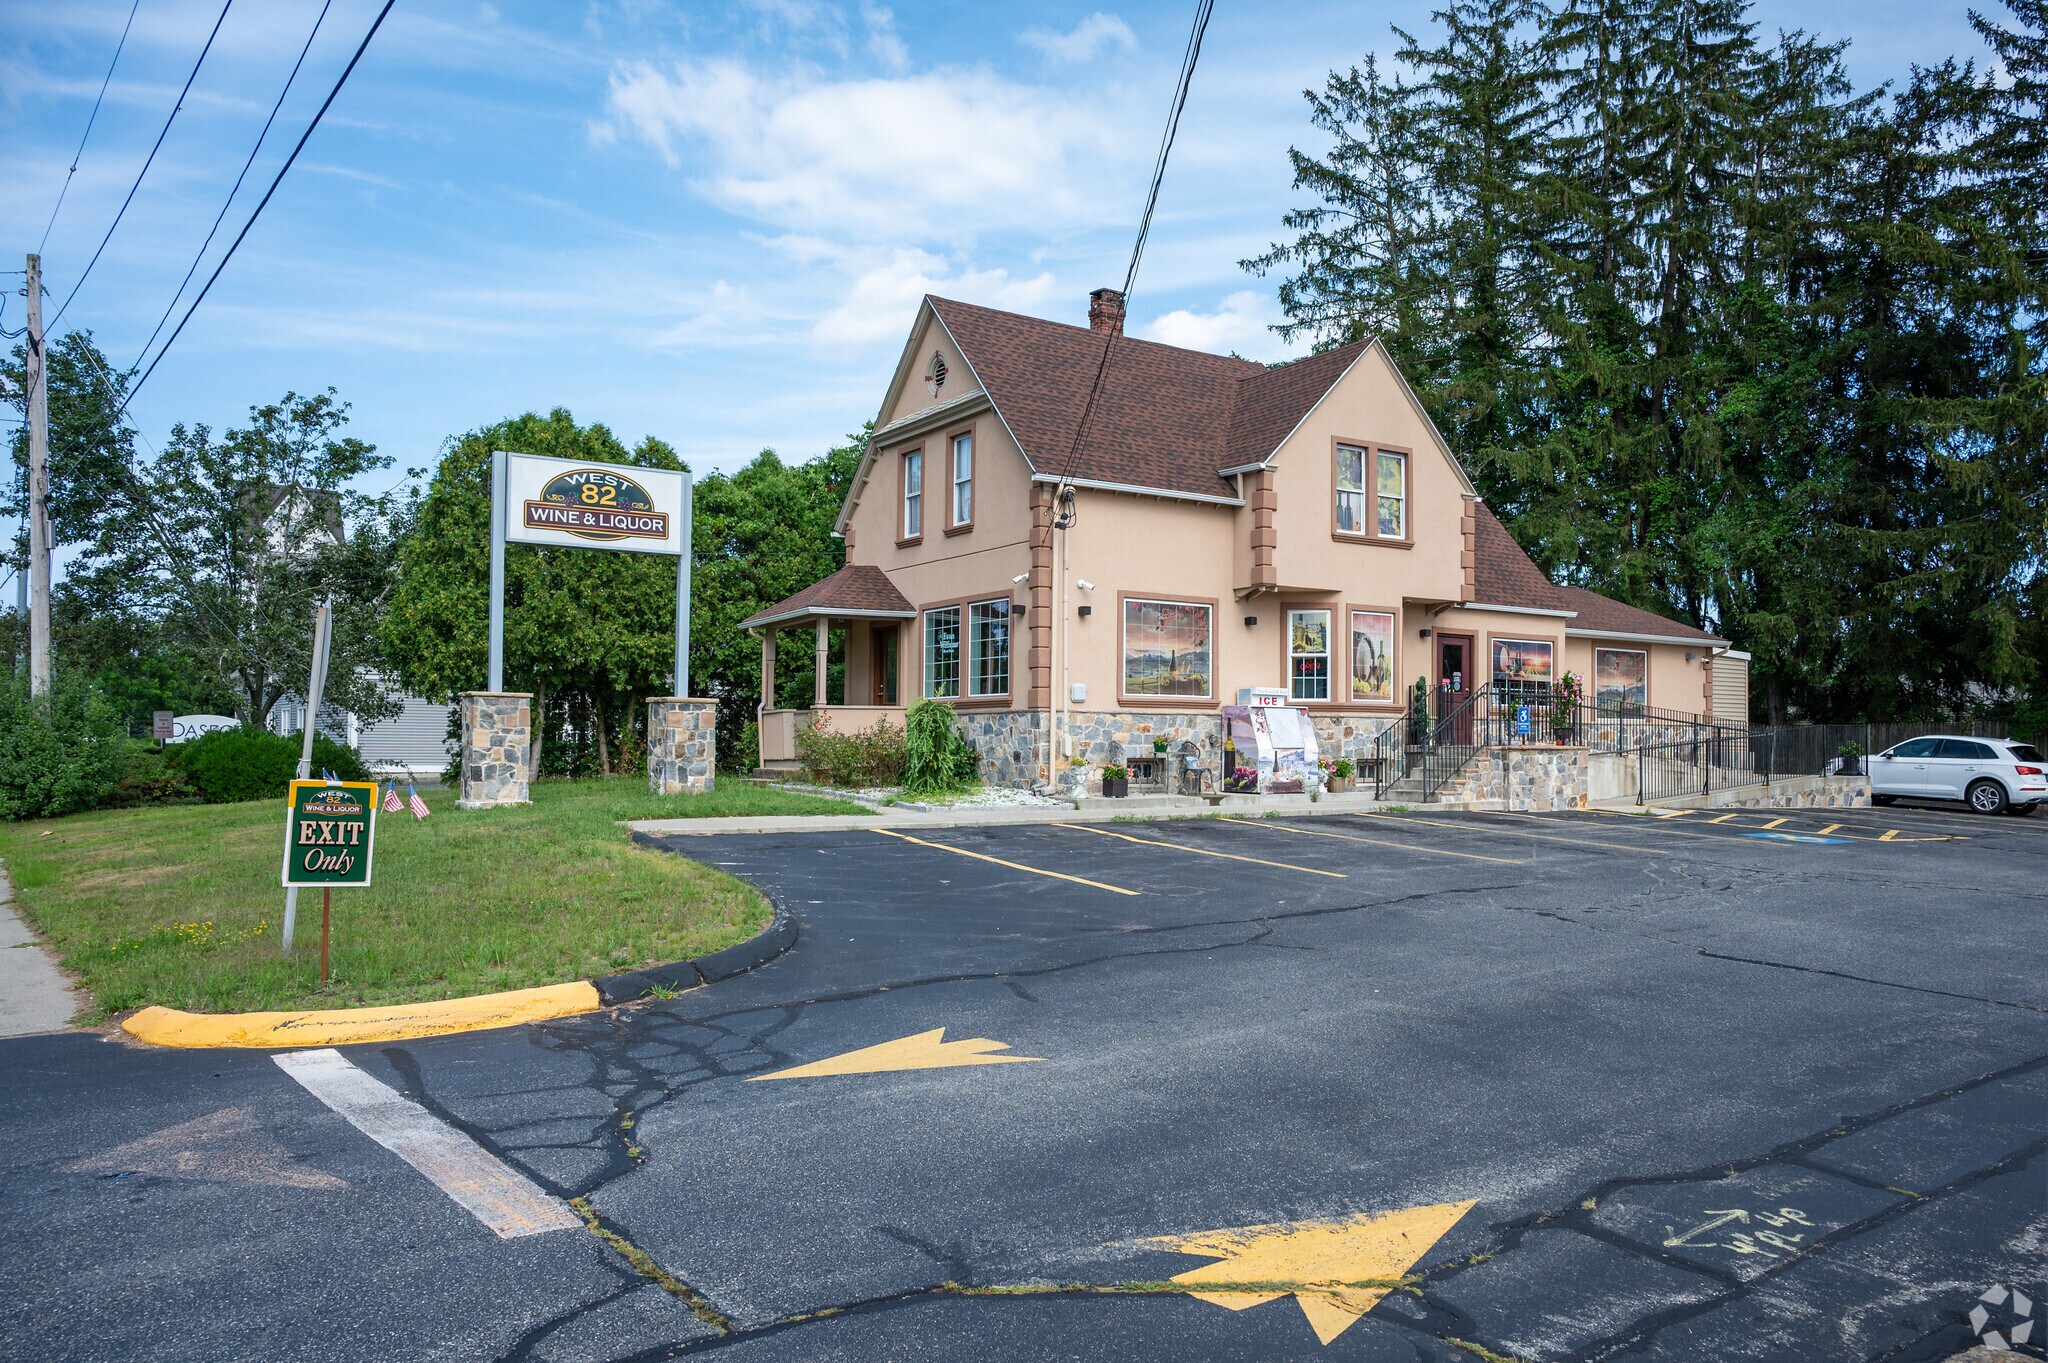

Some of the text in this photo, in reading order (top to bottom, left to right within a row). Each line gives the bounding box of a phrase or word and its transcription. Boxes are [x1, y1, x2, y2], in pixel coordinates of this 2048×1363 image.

[564, 473, 633, 491] WEST
[581, 484, 617, 507] 82
[531, 507, 664, 532] WINE & LIQUOR
[1259, 697, 1278, 705] ICE
[317, 791, 351, 799] WEST
[326, 796, 341, 804] 82
[333, 805, 360, 813] LIQUOR
[298, 820, 365, 845] EXIT
[304, 848, 355, 875] Only
